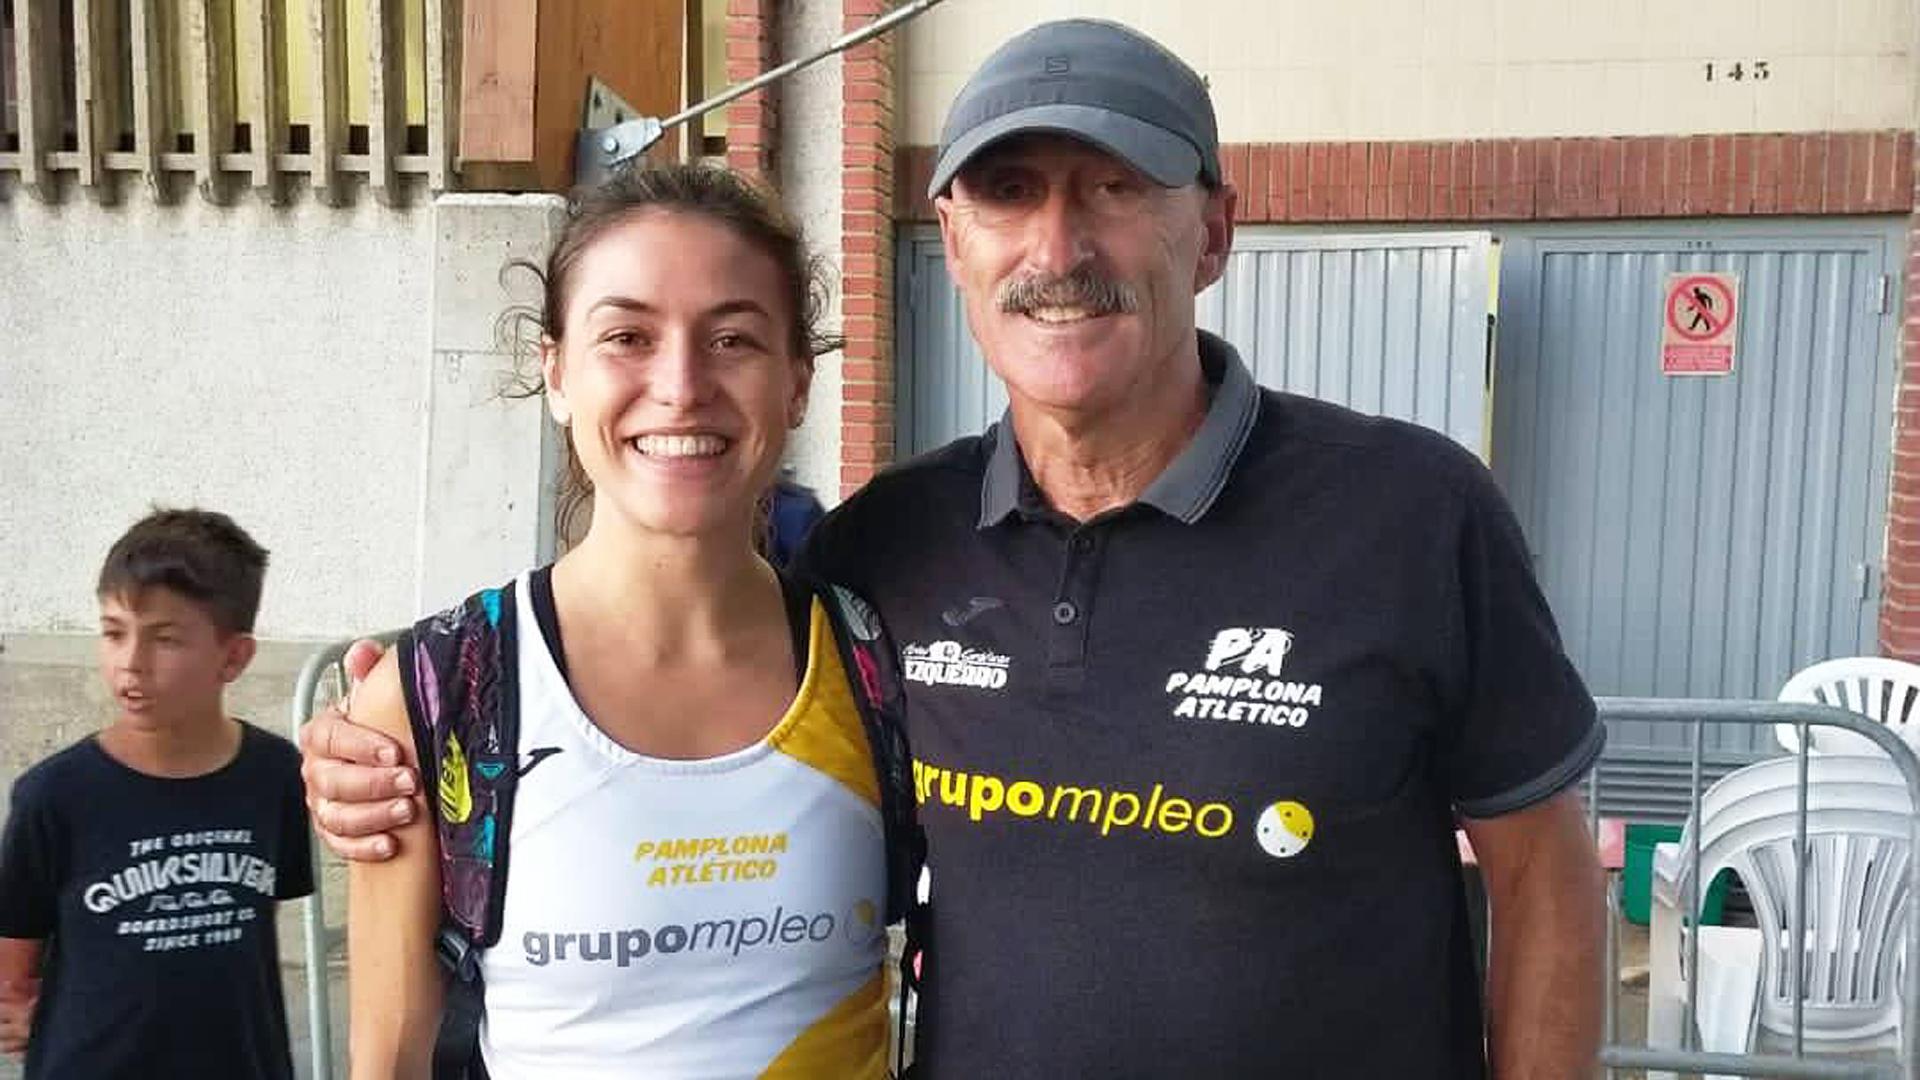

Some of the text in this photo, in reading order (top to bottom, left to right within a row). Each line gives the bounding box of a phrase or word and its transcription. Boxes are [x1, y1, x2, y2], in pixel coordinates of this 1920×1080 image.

[1205, 627, 1295, 677] PA
[1165, 671, 1323, 706] PAMPLONA
[912, 757, 1235, 838] grupompleo
[129, 837, 164, 858] THE
[635, 832, 788, 861] PAMPLONA
[84, 852, 277, 913] QUIKSILVER
[143, 933, 200, 952] SINCE
[522, 906, 836, 967] grupompleo
